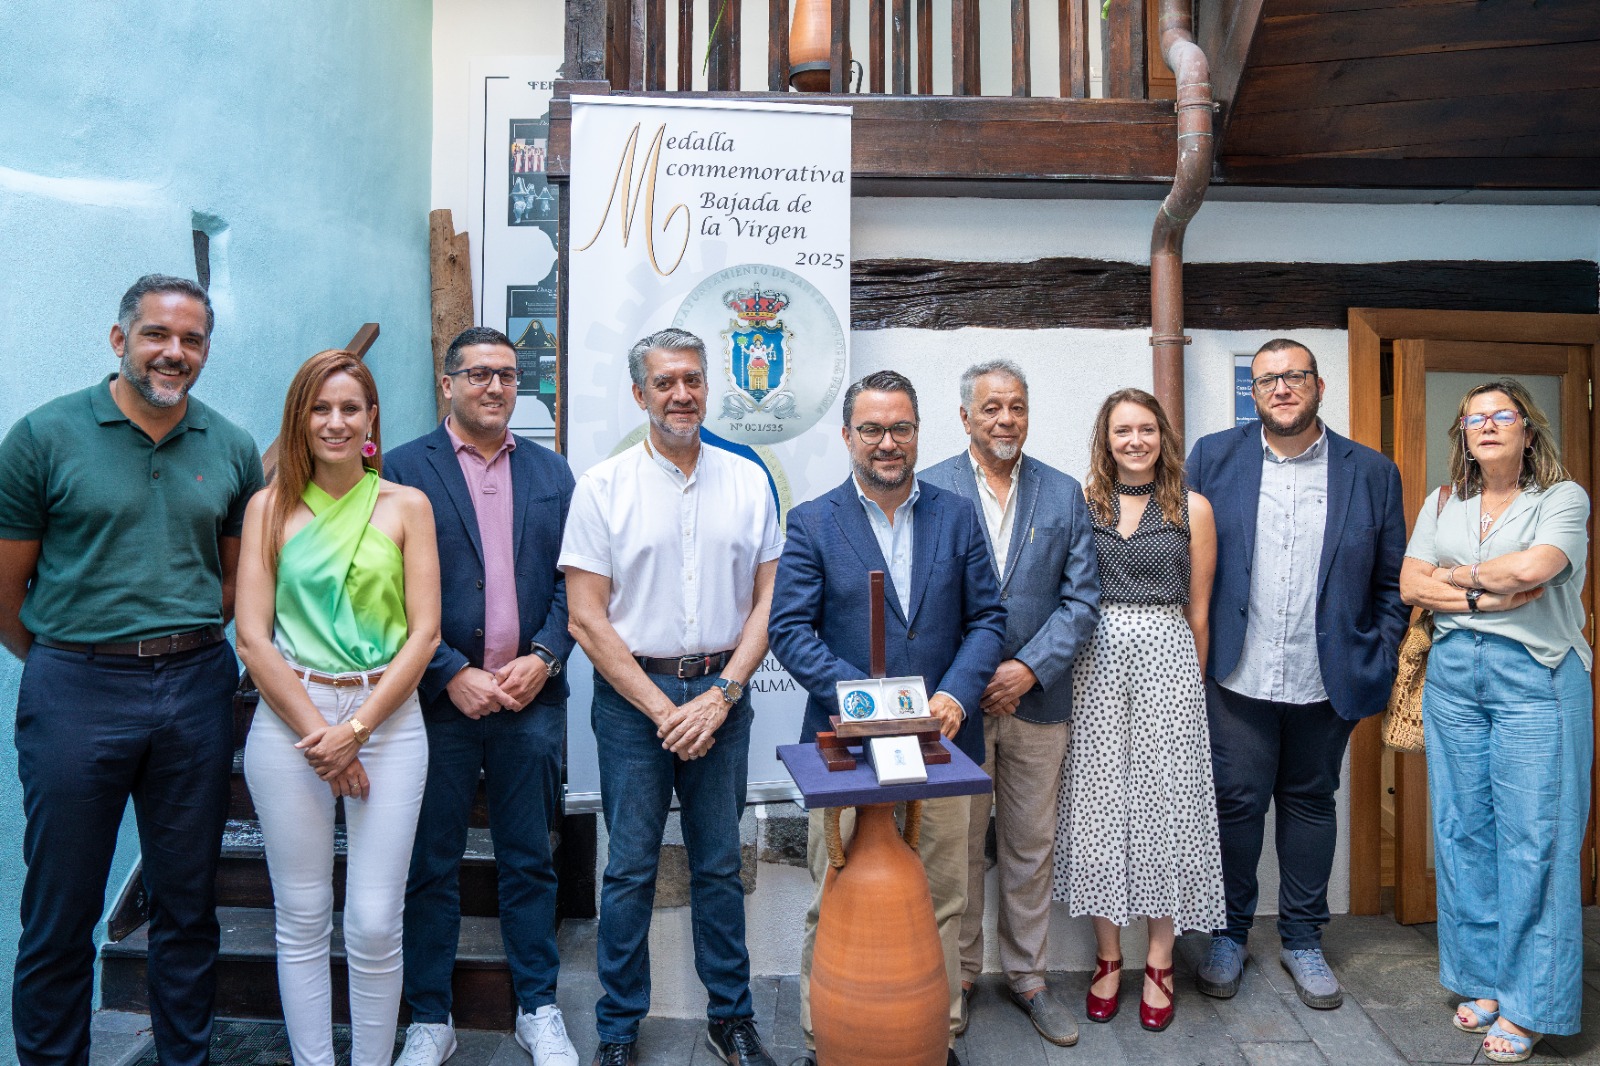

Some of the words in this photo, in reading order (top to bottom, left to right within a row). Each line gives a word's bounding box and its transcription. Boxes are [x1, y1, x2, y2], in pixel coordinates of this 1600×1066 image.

[666, 161, 845, 183] conmemorativa
[700, 191, 780, 216] Bajada
[787, 194, 812, 213] de
[700, 216, 721, 236] la
[729, 216, 807, 244] Virgen
[795, 252, 845, 269] 2025
[751, 678, 796, 692] ALMA
